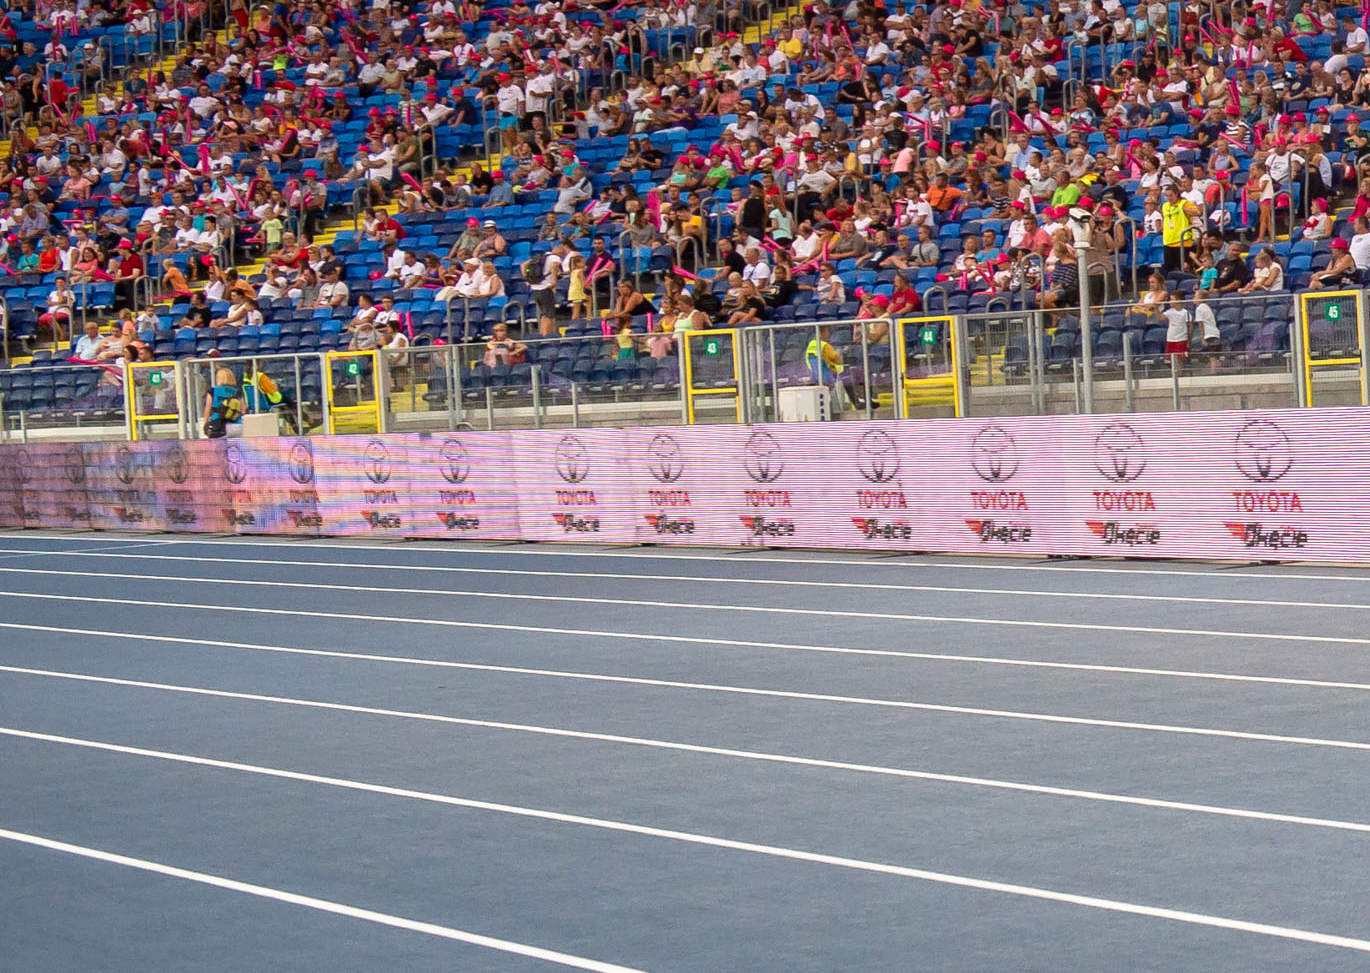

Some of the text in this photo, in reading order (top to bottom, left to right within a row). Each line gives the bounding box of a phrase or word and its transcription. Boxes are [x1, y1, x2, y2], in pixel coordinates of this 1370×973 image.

[1328, 306, 1338, 318] 45
[924, 331, 933, 342] 44
[708, 342, 716, 353] 43
[438, 490, 477, 505] TOYOTA
[555, 490, 597, 506] TOYOTA
[648, 490, 692, 507] TOYOTA
[744, 490, 791, 508] TOYOTA
[856, 490, 908, 509] TOYOTA
[970, 491, 1028, 511] TOYOTA
[1093, 490, 1156, 512] TOYOTA
[1232, 490, 1303, 513] TOYOTA
